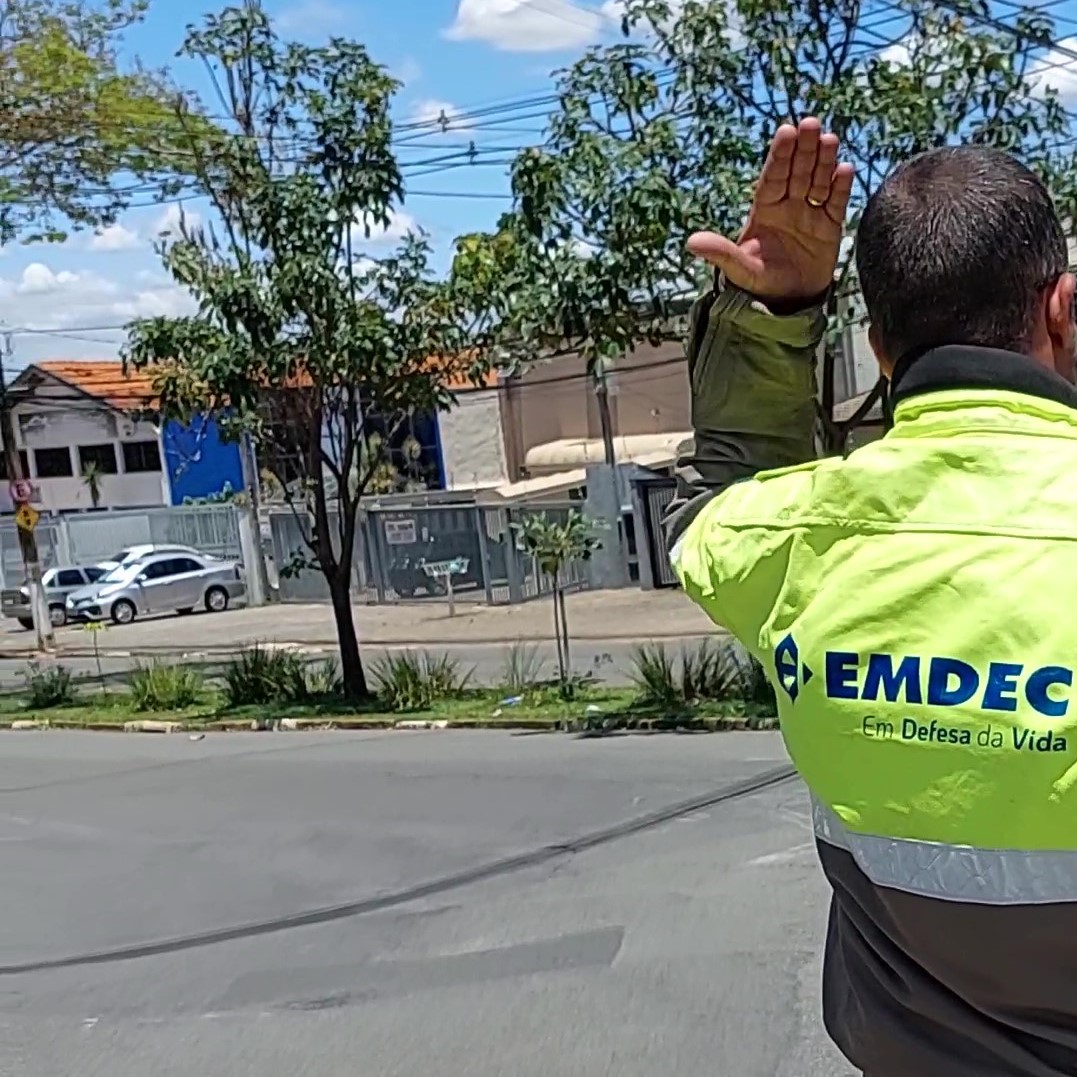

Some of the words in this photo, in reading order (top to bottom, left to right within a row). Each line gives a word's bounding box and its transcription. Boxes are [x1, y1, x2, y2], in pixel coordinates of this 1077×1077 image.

[825, 651, 1073, 717] EMDEC
[863, 715, 894, 738] Em
[902, 719, 971, 745] Defesa
[977, 723, 1003, 748] da
[1012, 727, 1067, 752] Vida
